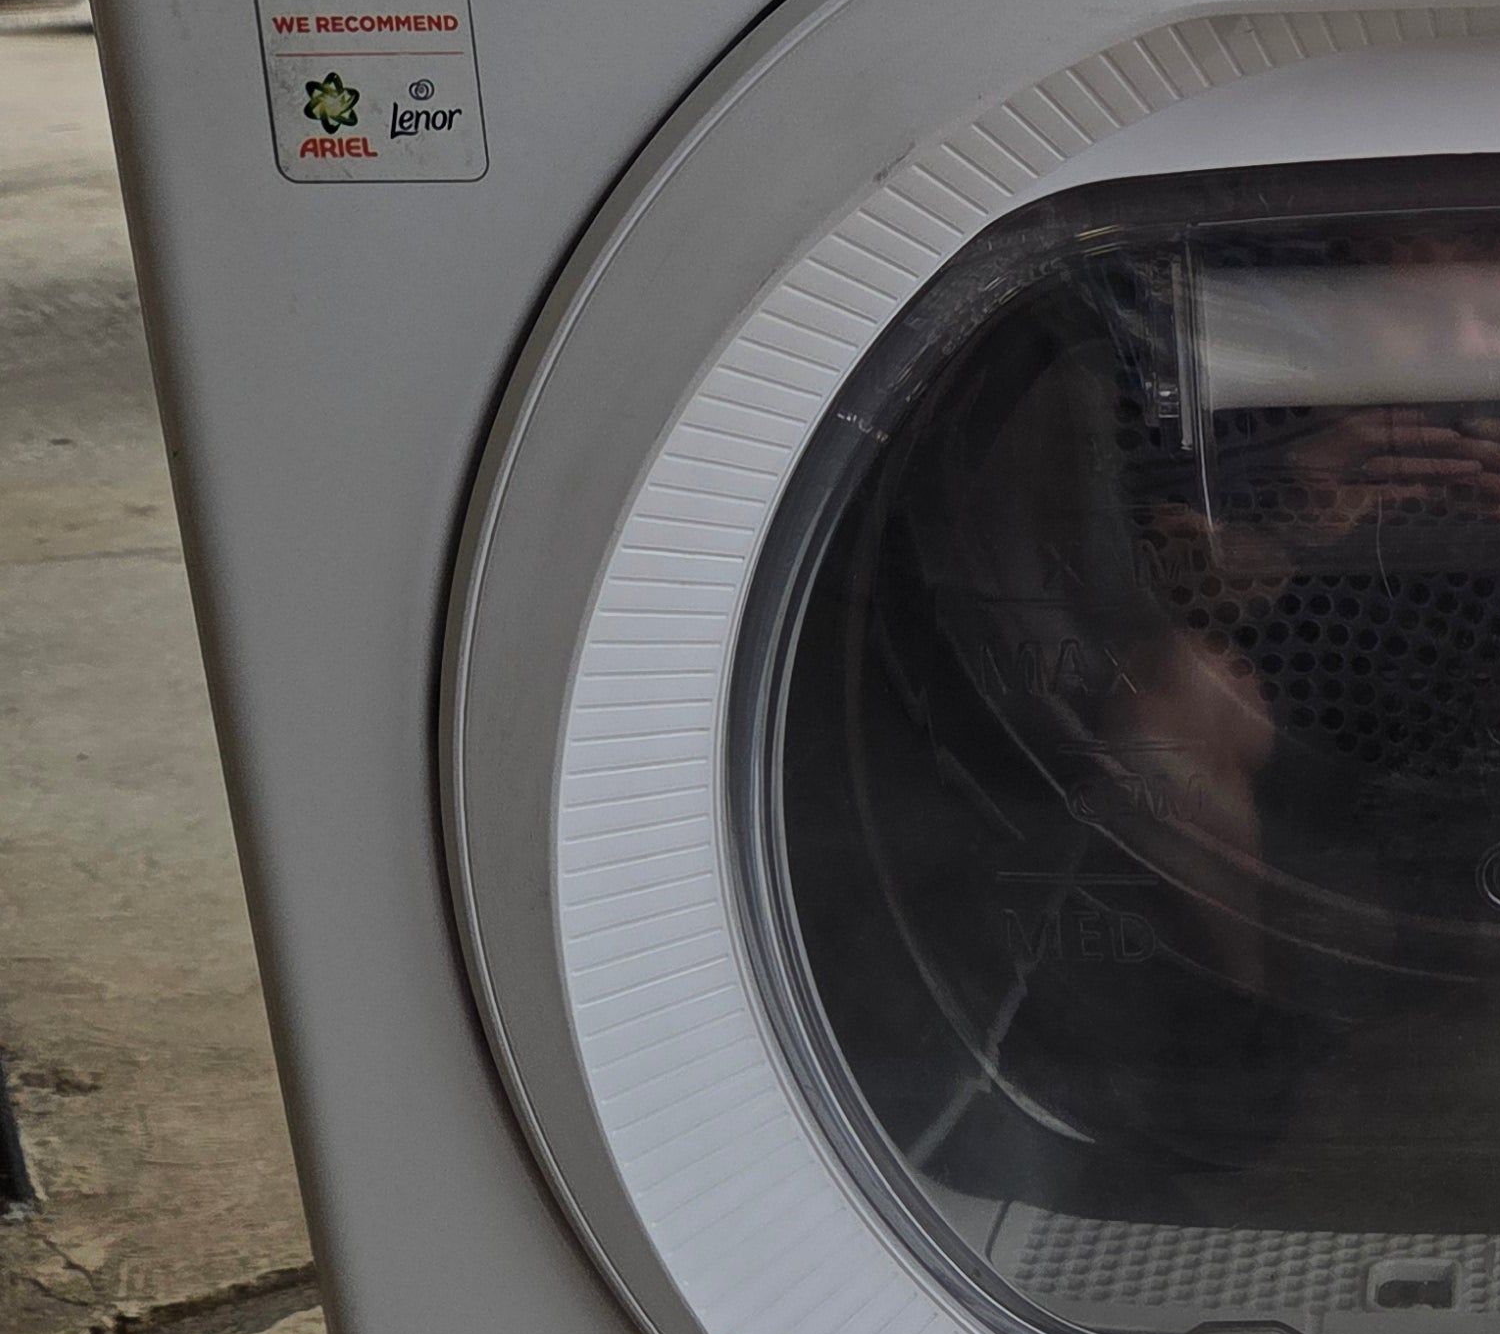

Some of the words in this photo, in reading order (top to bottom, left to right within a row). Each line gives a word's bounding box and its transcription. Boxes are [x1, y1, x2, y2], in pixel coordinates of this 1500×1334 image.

[272, 17, 311, 34] WE
[315, 15, 458, 33] RECOMMEND
[390, 102, 462, 139] Lenor
[300, 137, 378, 158] ARIEL
[1001, 907, 1160, 963] MED
